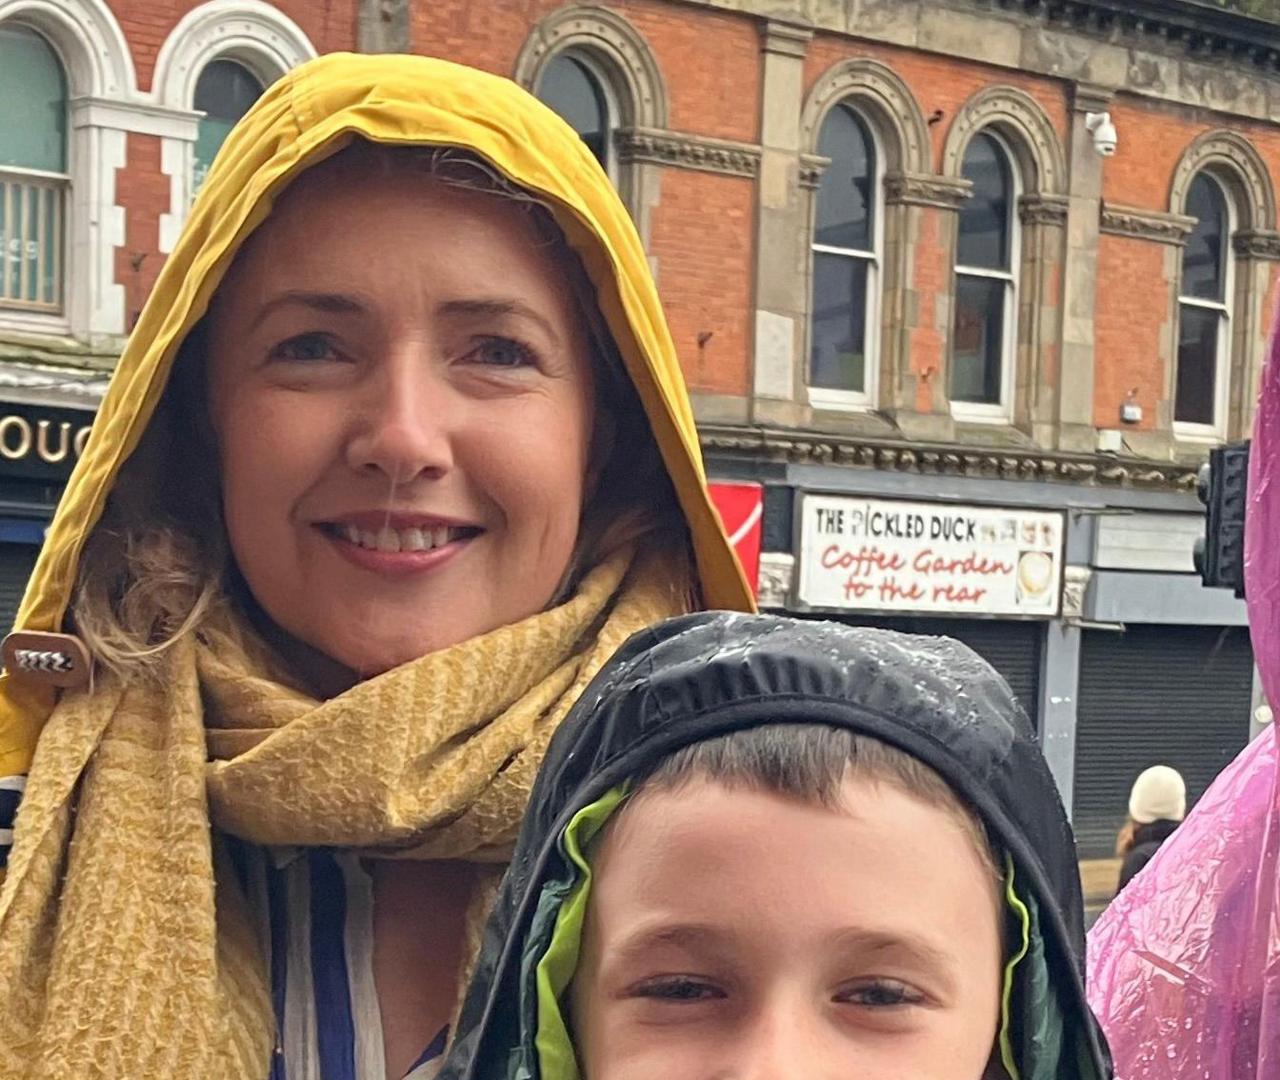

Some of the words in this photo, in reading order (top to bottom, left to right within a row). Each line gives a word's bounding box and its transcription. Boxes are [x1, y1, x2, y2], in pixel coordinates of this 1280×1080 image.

[816, 508, 844, 534] THE
[930, 516, 977, 542] DUCK
[820, 544, 906, 577] Coffee
[912, 550, 1014, 576] Garden
[843, 575, 873, 600] to
[878, 576, 925, 600] the
[931, 584, 987, 605] rear
